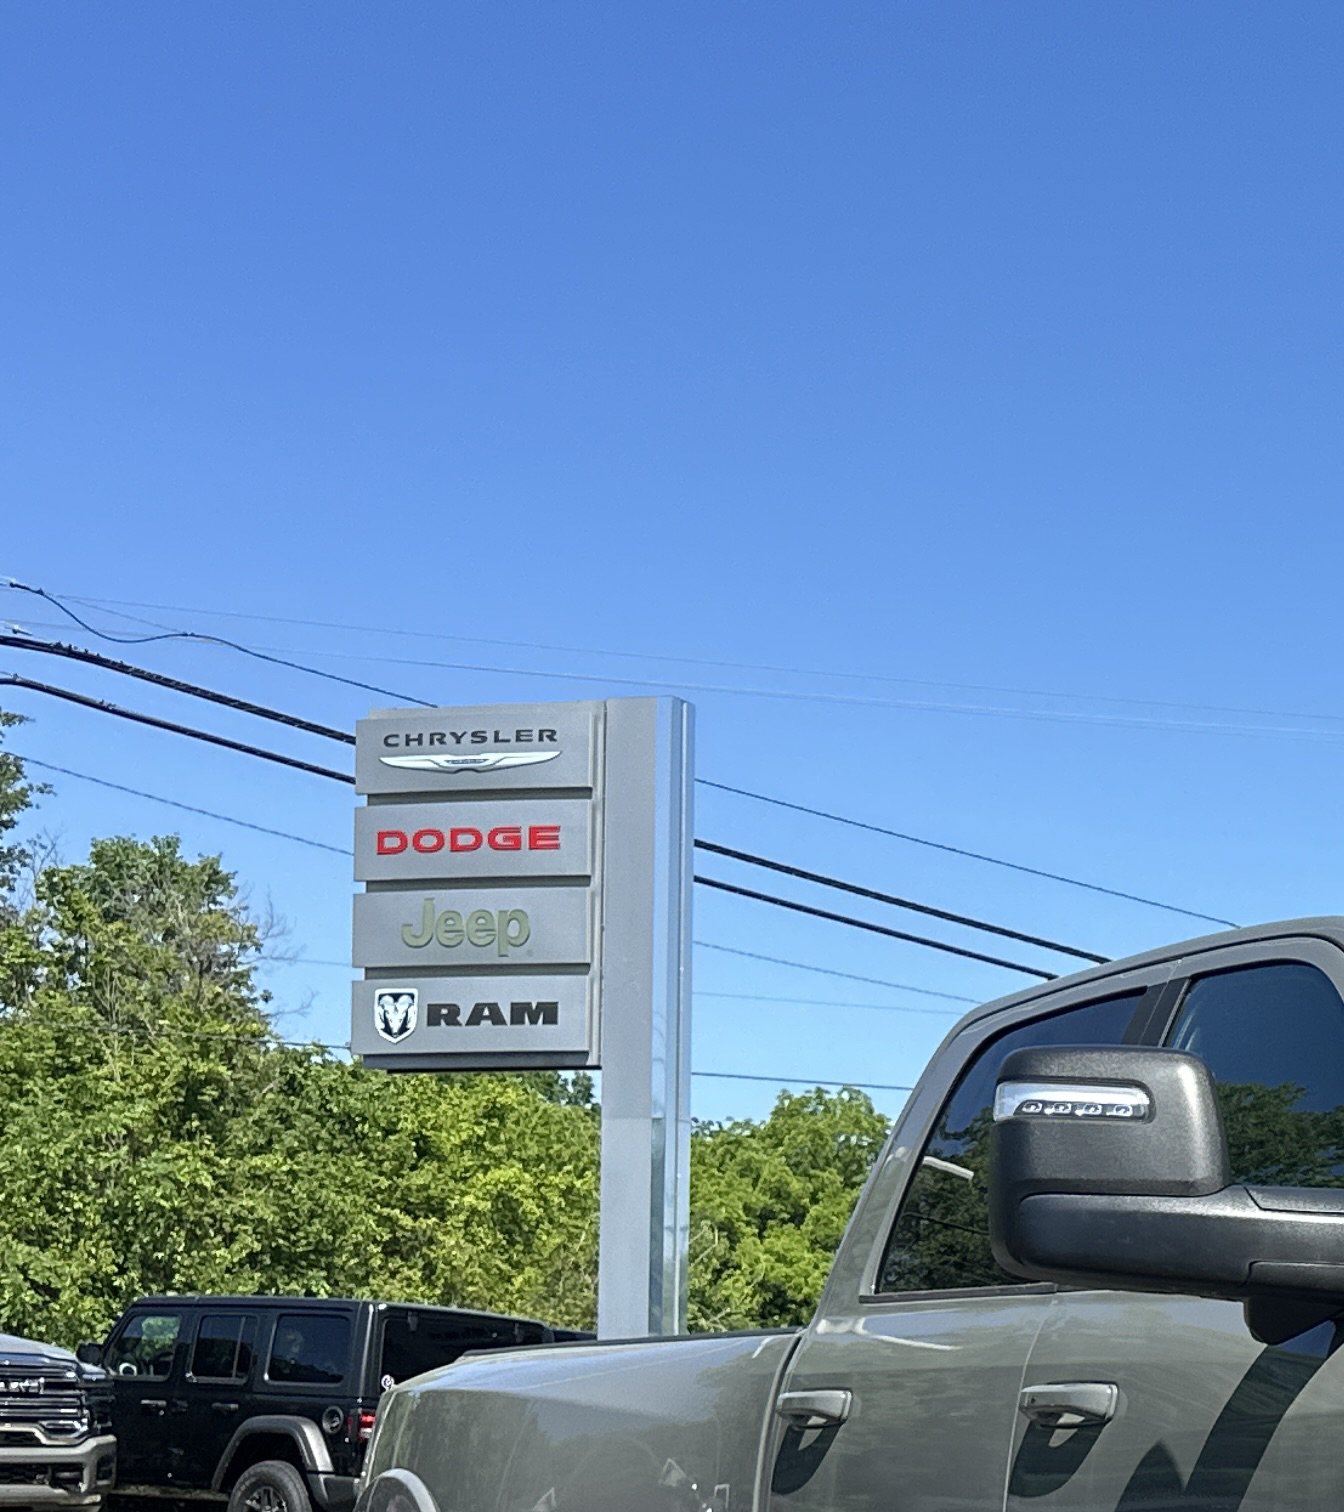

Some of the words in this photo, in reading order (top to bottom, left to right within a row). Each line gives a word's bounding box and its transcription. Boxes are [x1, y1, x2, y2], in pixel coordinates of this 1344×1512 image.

[383, 728, 558, 748] CHRYSLER
[376, 825, 561, 855] DODGE
[401, 897, 531, 957] Jeep
[426, 1001, 560, 1027] RAM
